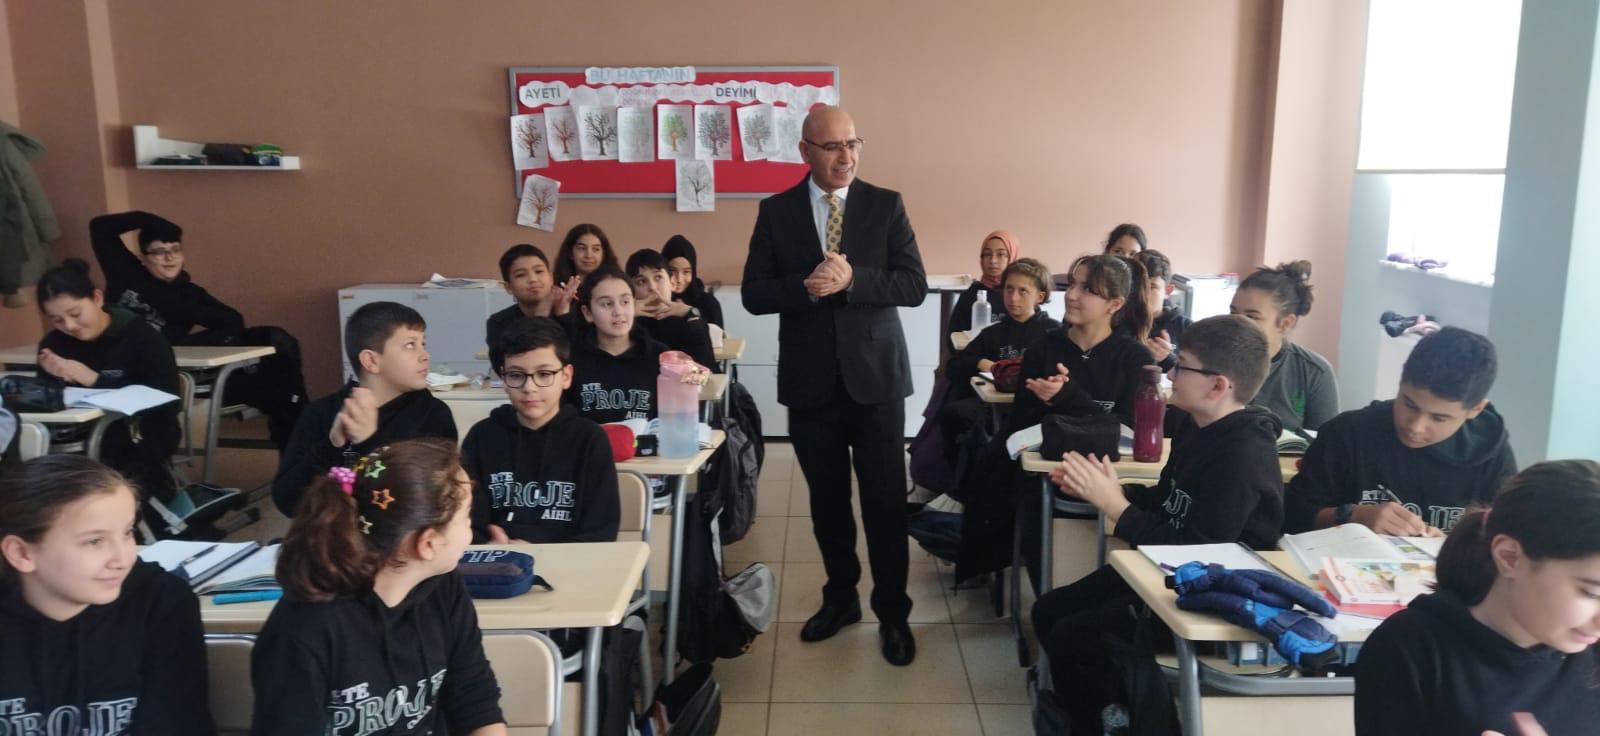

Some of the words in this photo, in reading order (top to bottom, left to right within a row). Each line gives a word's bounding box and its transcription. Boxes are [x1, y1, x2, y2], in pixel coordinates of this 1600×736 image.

[525, 86, 561, 99] AYETİ
[580, 389, 651, 411] PROJE
[490, 472, 513, 483] RTE
[488, 481, 576, 508] PROJE
[541, 507, 572, 521] AİHL
